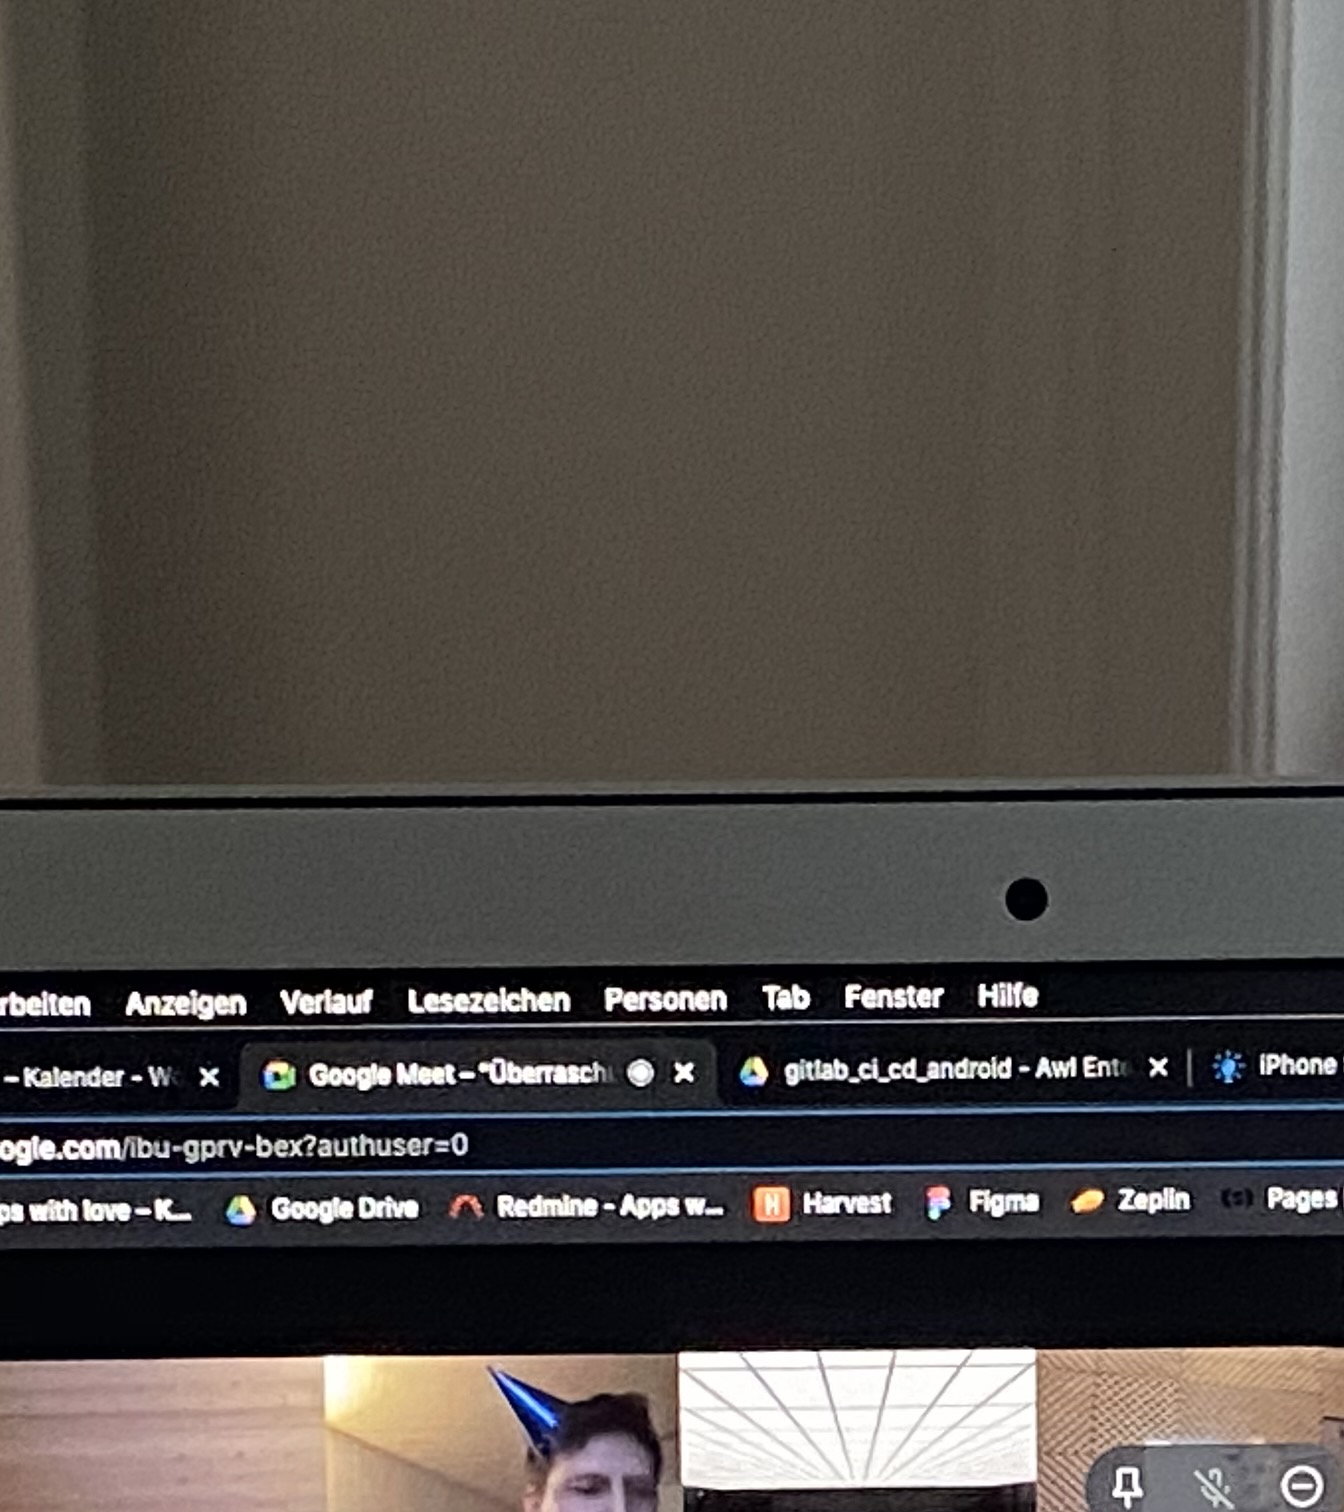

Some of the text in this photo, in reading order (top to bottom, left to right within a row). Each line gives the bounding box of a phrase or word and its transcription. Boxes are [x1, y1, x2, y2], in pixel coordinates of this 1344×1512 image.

[125, 992, 246, 1021] Anzeigen
[280, 989, 373, 1014] Verlauf
[408, 988, 570, 1014] Lesezeichen
[605, 988, 727, 1013] Personen
[763, 985, 810, 1010] Tab
[845, 984, 944, 1009] Fenster
[979, 983, 1039, 1008] Hilfe
[1260, 1052, 1337, 1075] iPhone
[24, 1067, 125, 1088] Kalender
[309, 1063, 391, 1091] Google
[397, 1062, 455, 1085] Meet
[29, 1200, 78, 1222] with
[83, 1199, 131, 1221] love
[272, 1196, 419, 1225] Google Drive
[497, 1195, 598, 1219] Redmine
[620, 1194, 680, 1221] Apps
[803, 1191, 892, 1215] Harvest
[970, 1189, 1040, 1218] Figma
[1118, 1187, 1191, 1216] Zeplin
[1267, 1186, 1337, 1216] Pages
